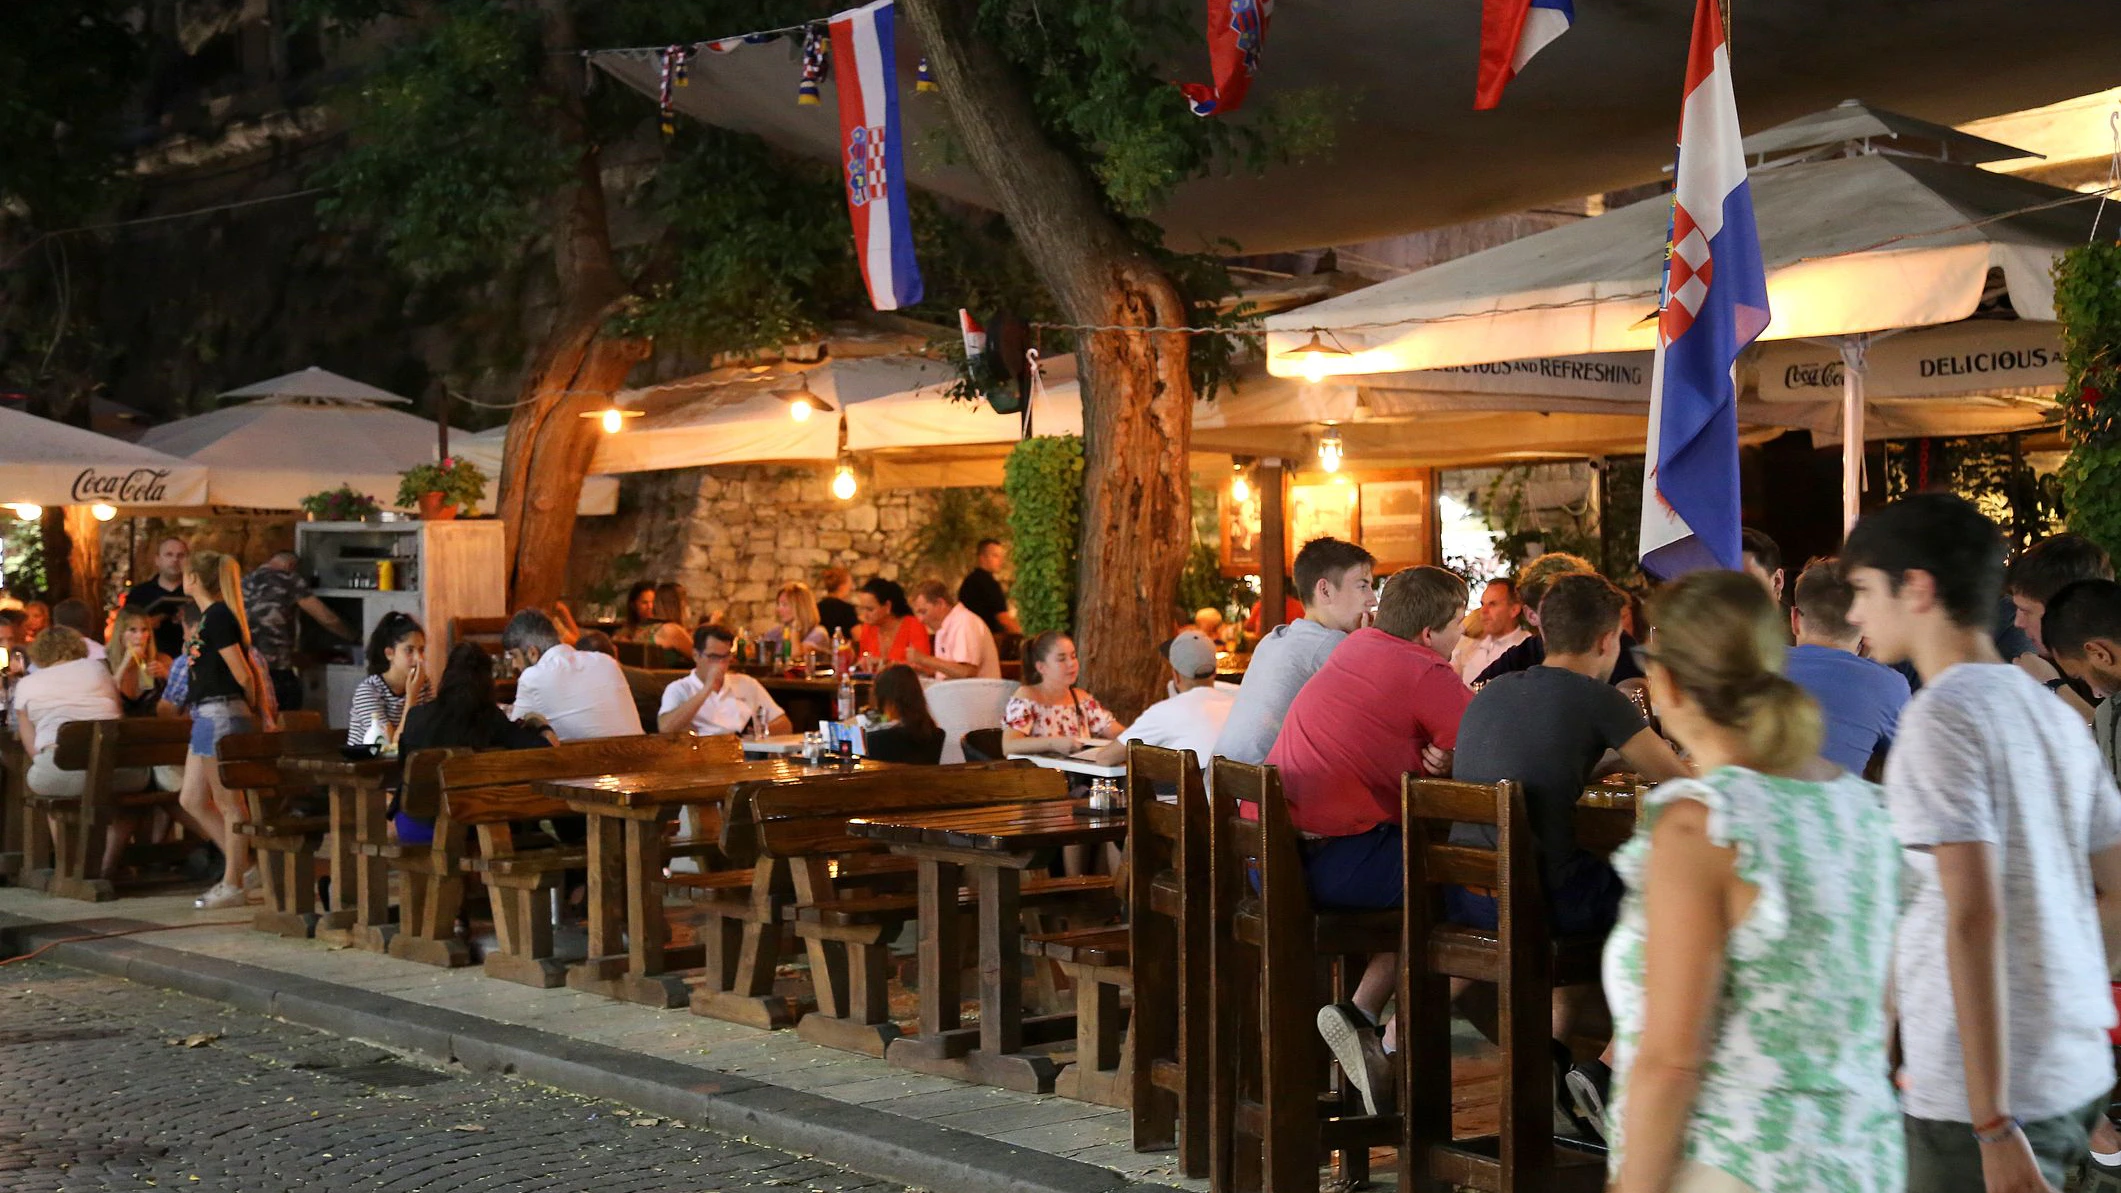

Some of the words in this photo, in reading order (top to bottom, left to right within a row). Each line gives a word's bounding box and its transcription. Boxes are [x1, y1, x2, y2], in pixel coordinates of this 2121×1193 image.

[1513, 361, 1538, 373] AND
[1540, 358, 1642, 385] REFRESHING
[1920, 348, 2048, 378] DELICIOUS
[71, 467, 171, 502] Coca-Cola
